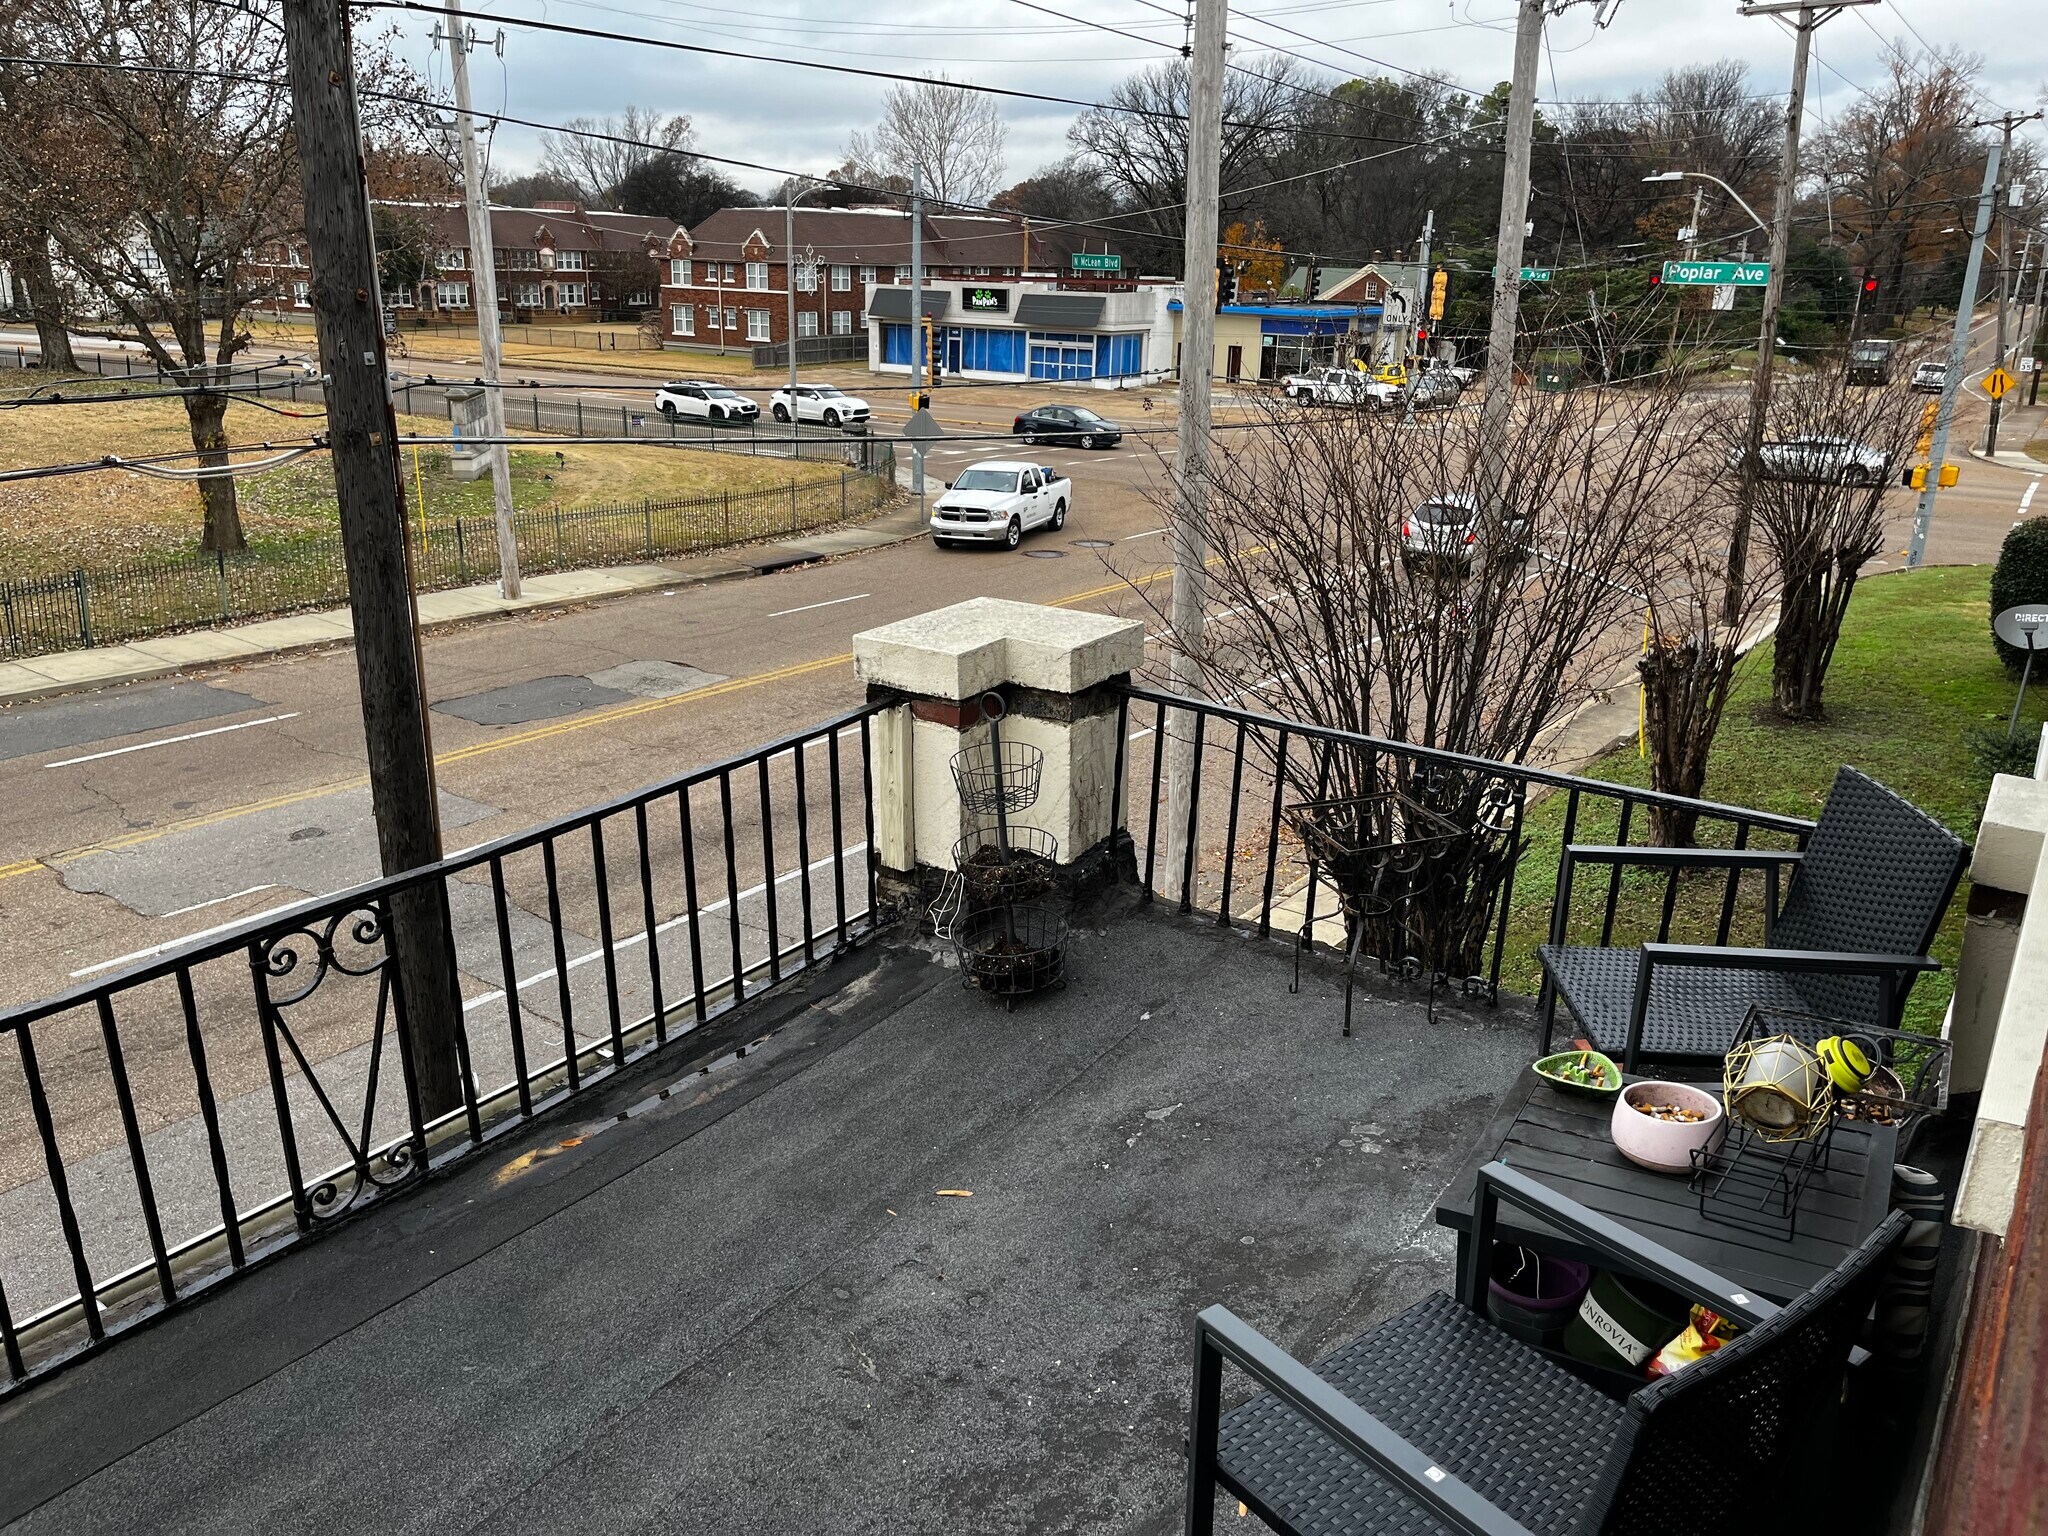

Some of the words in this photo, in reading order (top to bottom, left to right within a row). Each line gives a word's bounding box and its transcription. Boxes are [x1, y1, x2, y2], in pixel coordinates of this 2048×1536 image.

[1074, 257, 1079, 266] N
[1081, 257, 1101, 267] McLean
[1105, 258, 1118, 268] Blvd
[1528, 271, 1547, 279] Ave
[1669, 265, 1722, 281] Poplar
[1732, 266, 1764, 280] Ave
[1387, 314, 1408, 323] ONLY
[1583, 1299, 1633, 1355] ONROVIA
